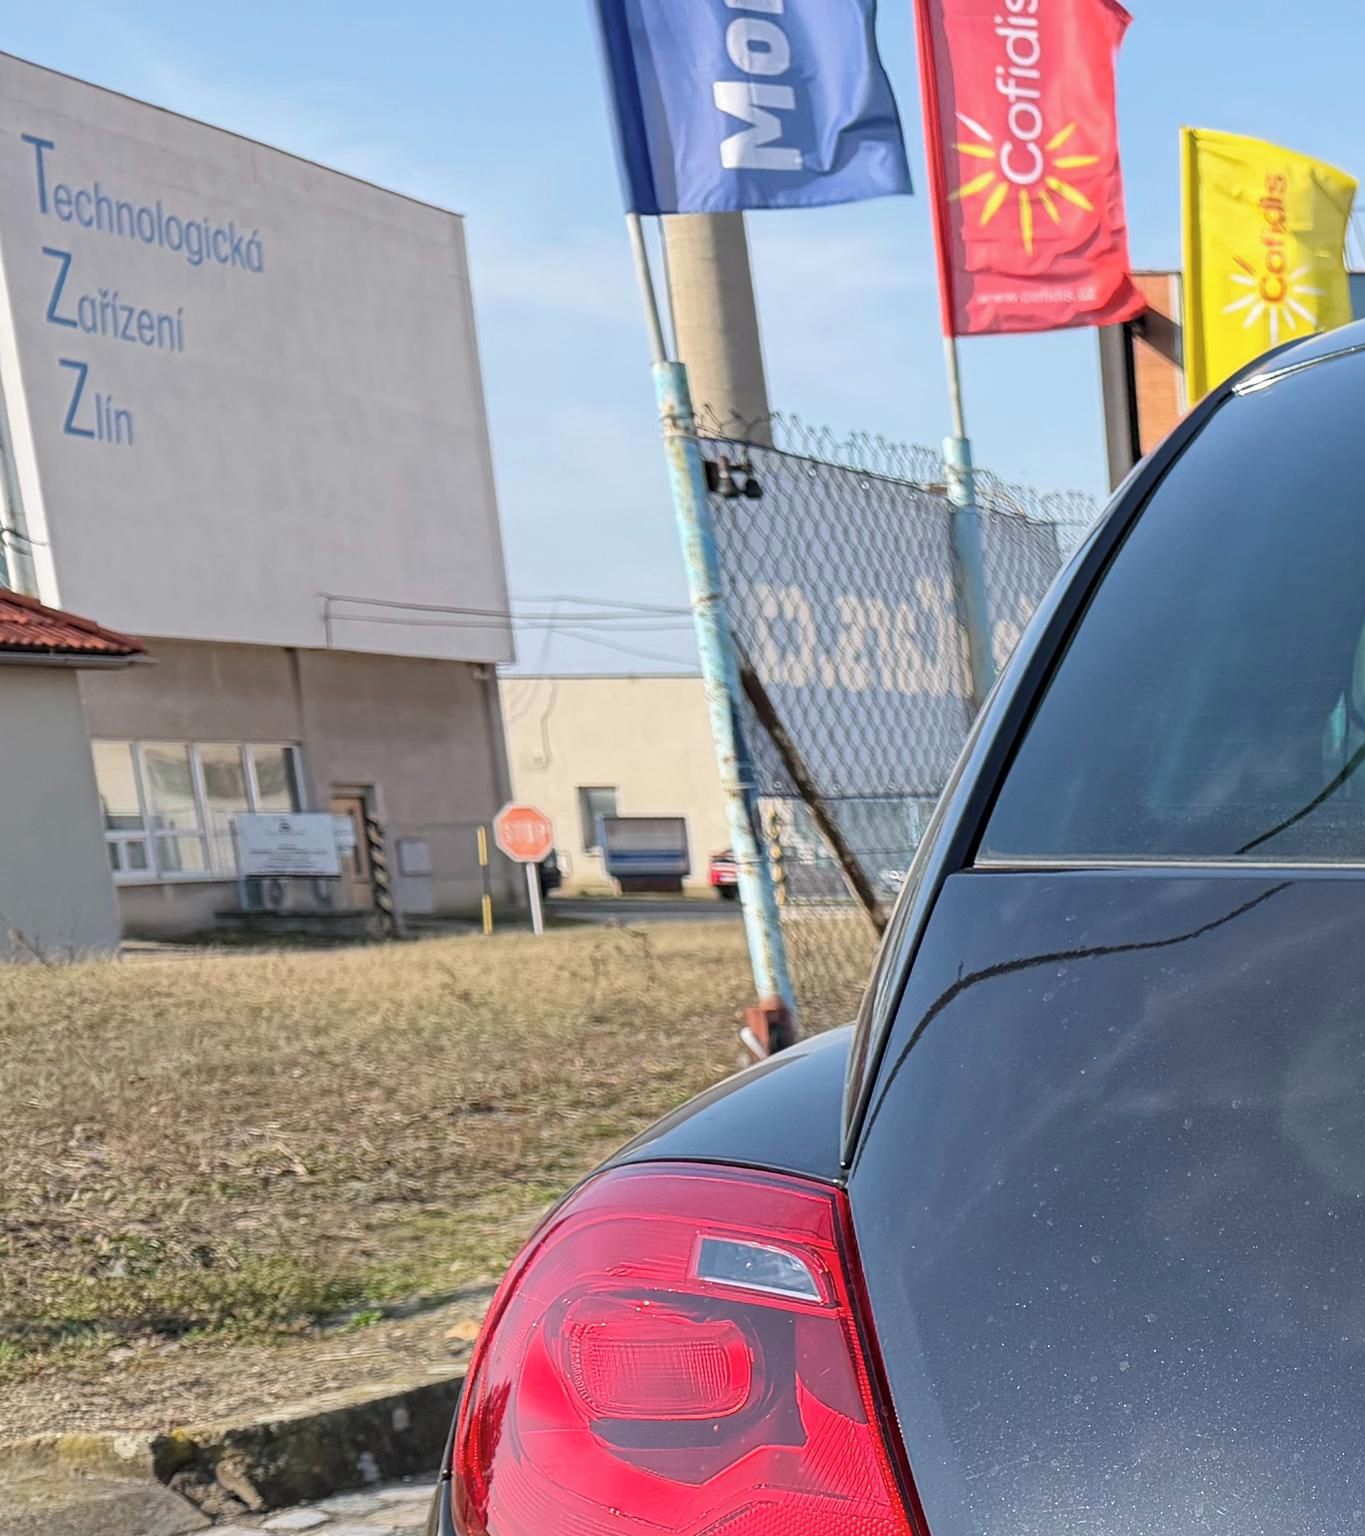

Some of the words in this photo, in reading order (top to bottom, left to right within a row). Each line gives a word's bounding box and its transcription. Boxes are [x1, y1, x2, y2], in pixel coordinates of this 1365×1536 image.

[713, 0, 802, 170] Mo
[21, 133, 264, 273] Technologická
[1260, 174, 1287, 303] Cofidis
[42, 246, 184, 352] Zařízení
[58, 358, 134, 446] Zlín
